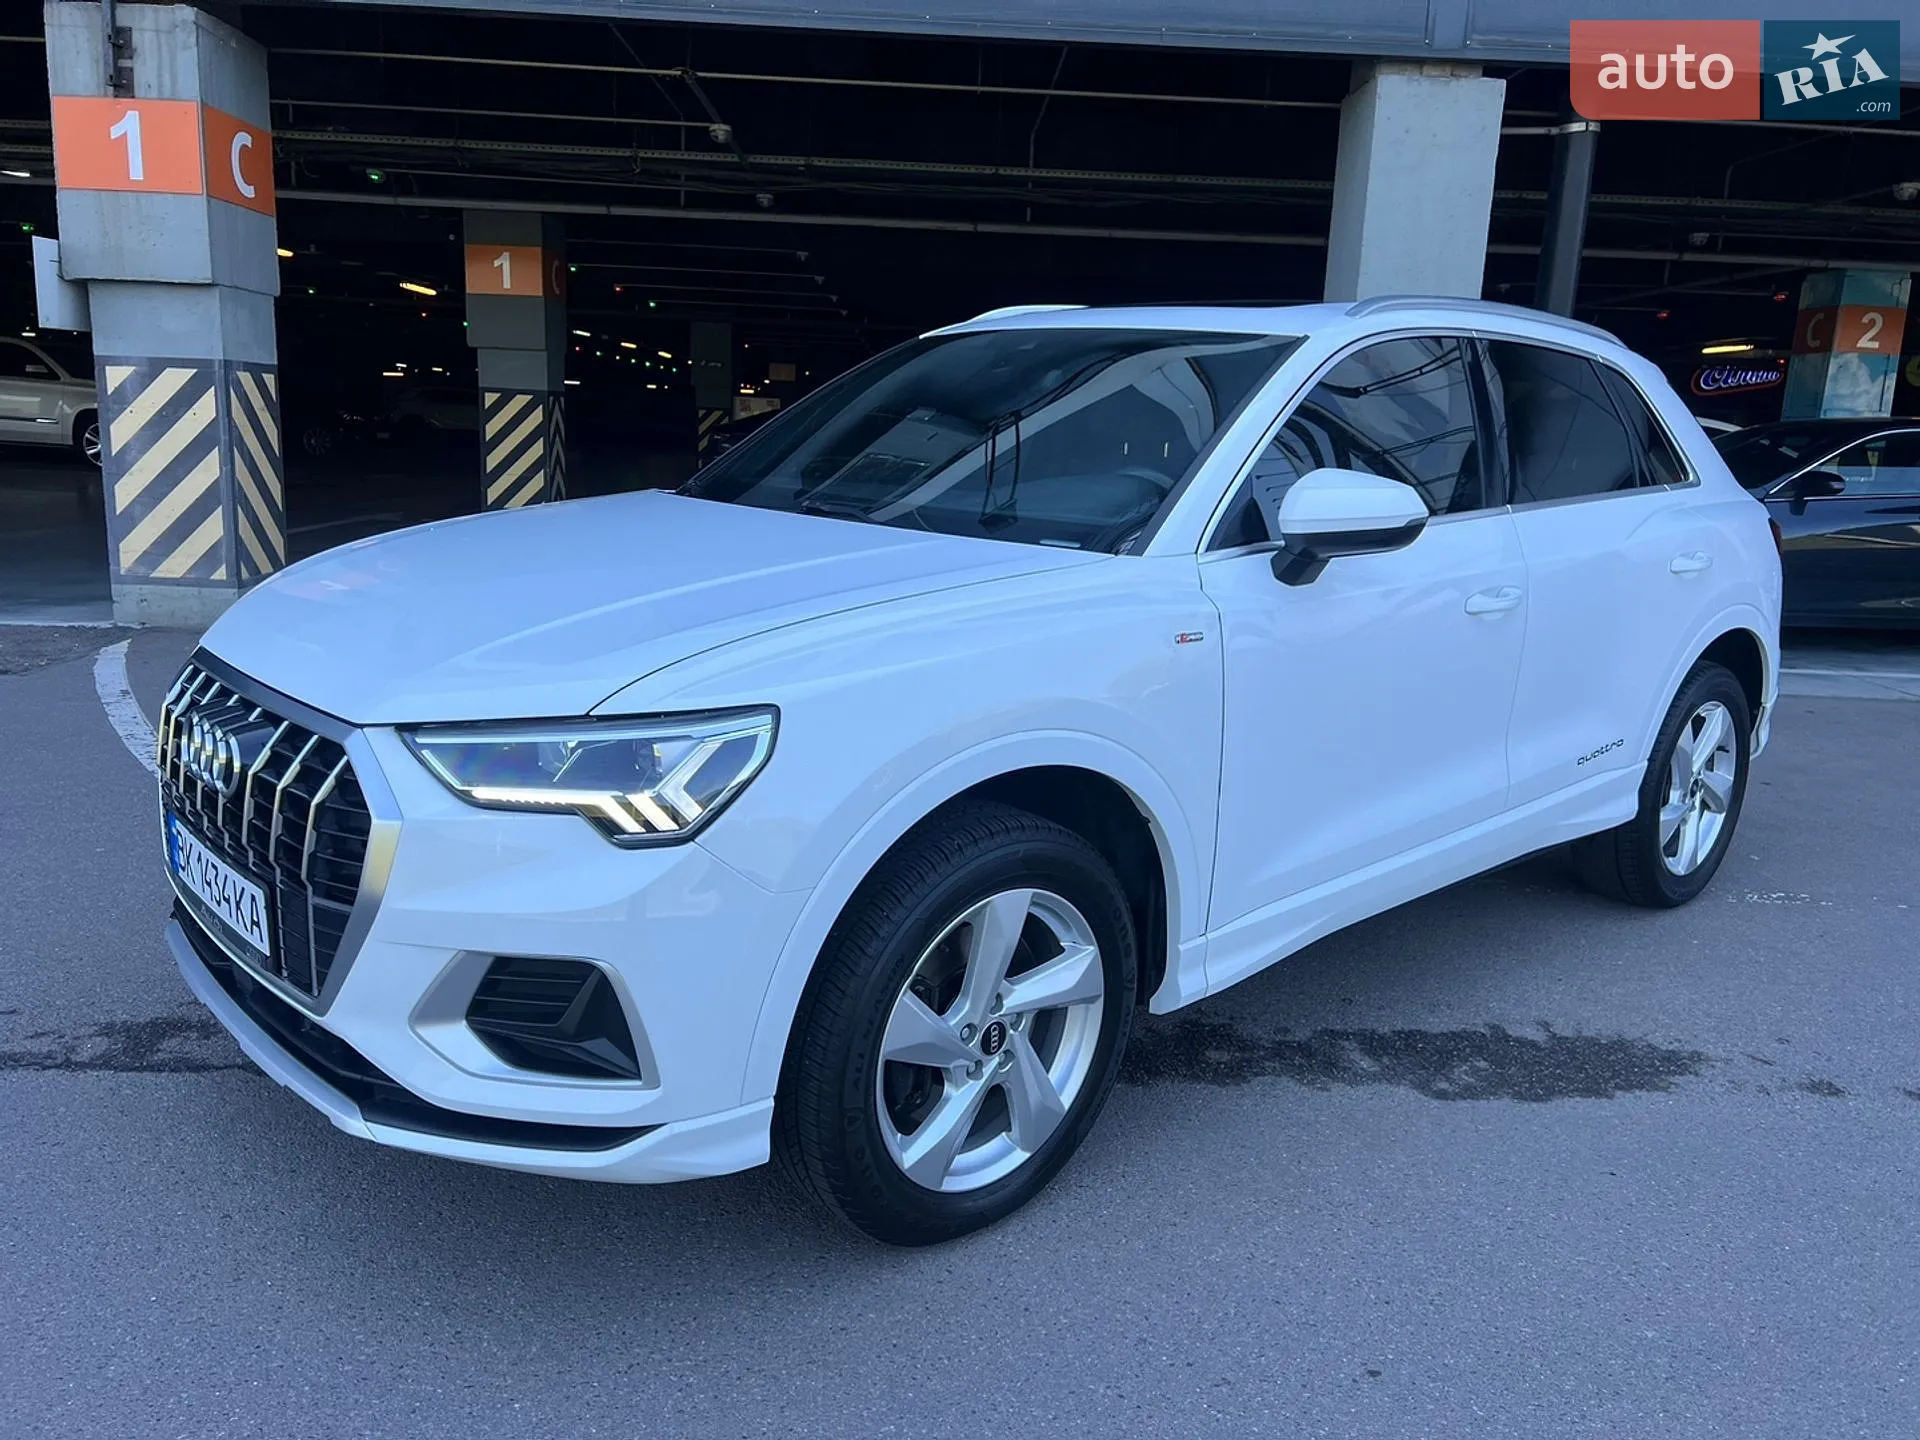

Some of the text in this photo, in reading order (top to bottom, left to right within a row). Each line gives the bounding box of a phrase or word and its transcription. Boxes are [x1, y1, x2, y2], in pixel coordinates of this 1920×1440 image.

[109, 110, 144, 181] 1
[229, 130, 256, 199] C
[492, 251, 511, 289] 1
[1806, 312, 1825, 348] C
[1856, 311, 1884, 349] 2
[1576, 738, 1625, 766] quattro
